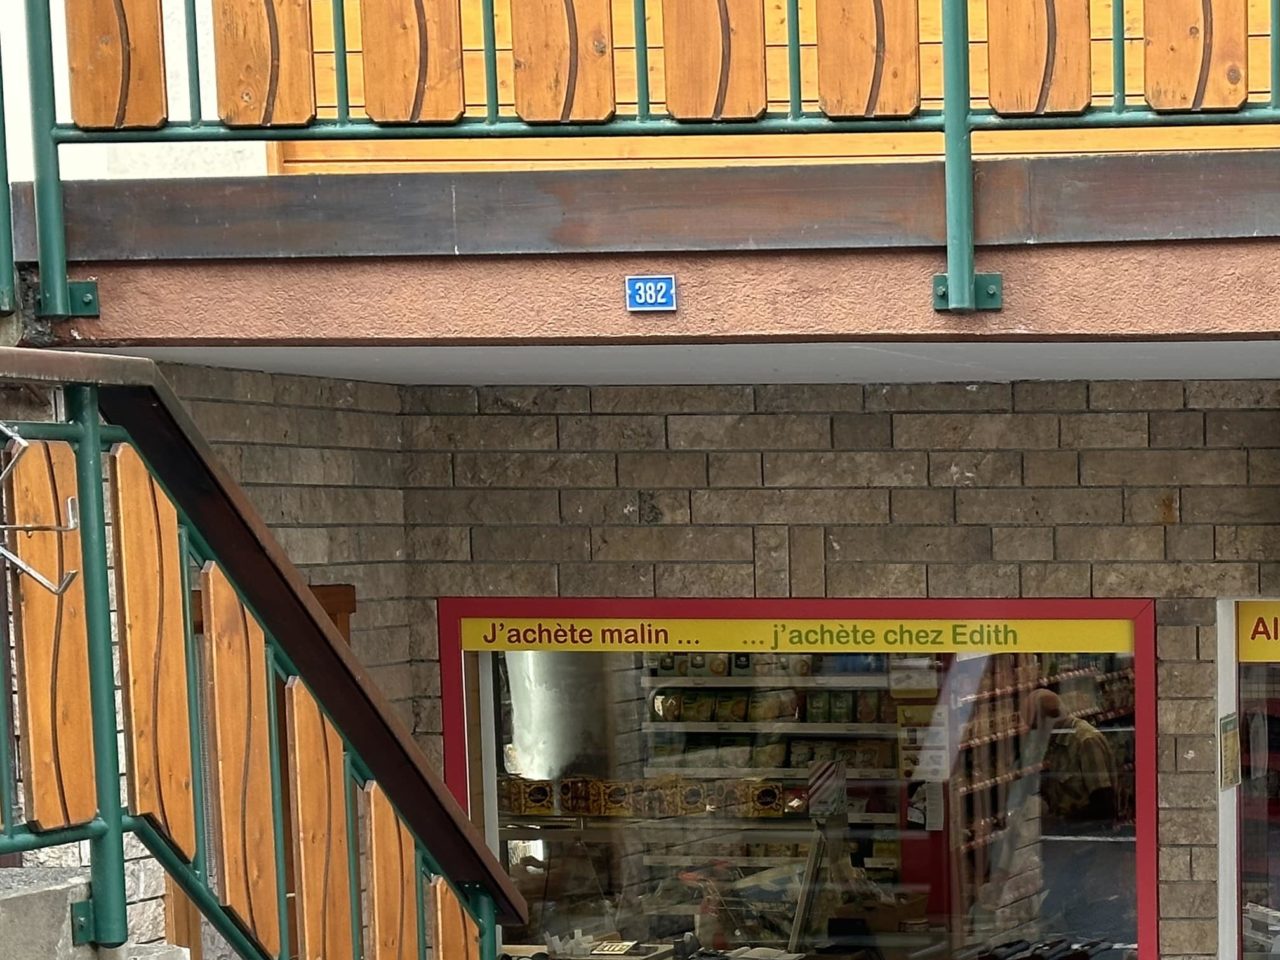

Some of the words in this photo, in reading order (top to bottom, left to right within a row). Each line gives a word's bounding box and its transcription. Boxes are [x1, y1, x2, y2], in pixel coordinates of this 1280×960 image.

[635, 282, 667, 304] 382
[483, 622, 593, 645] J'achète
[600, 623, 670, 646] malin
[770, 624, 877, 650] j'achète
[883, 624, 944, 646] chez
[951, 624, 1018, 646] Edith
